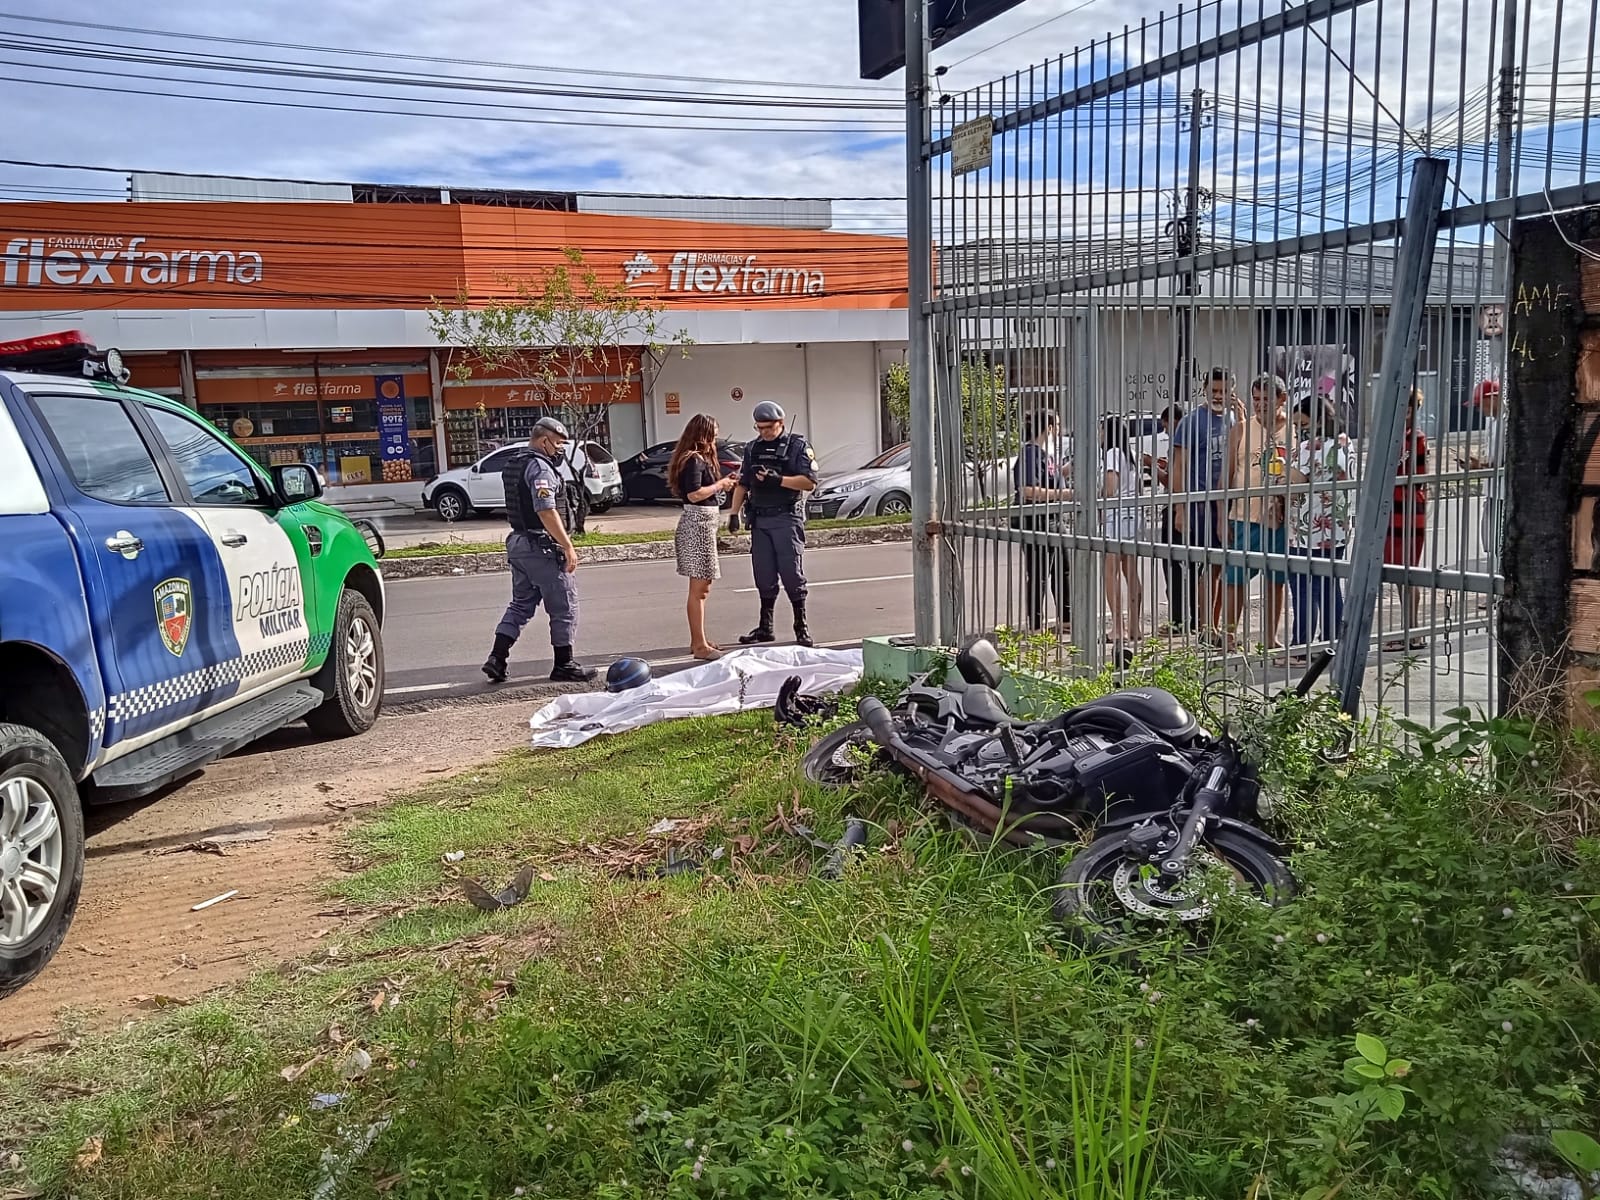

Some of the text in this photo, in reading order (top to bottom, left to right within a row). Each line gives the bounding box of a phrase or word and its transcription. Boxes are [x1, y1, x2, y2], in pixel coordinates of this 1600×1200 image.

[48, 235, 124, 250] FARMÁCIAS
[0, 237, 263, 287] flexfarma
[668, 251, 825, 295] flexfarma
[381, 415, 404, 424] DOTZ
[156, 581, 188, 602] AMAZONAS
[236, 561, 300, 622] POLÍCIA
[259, 608, 302, 639] MILITAR
